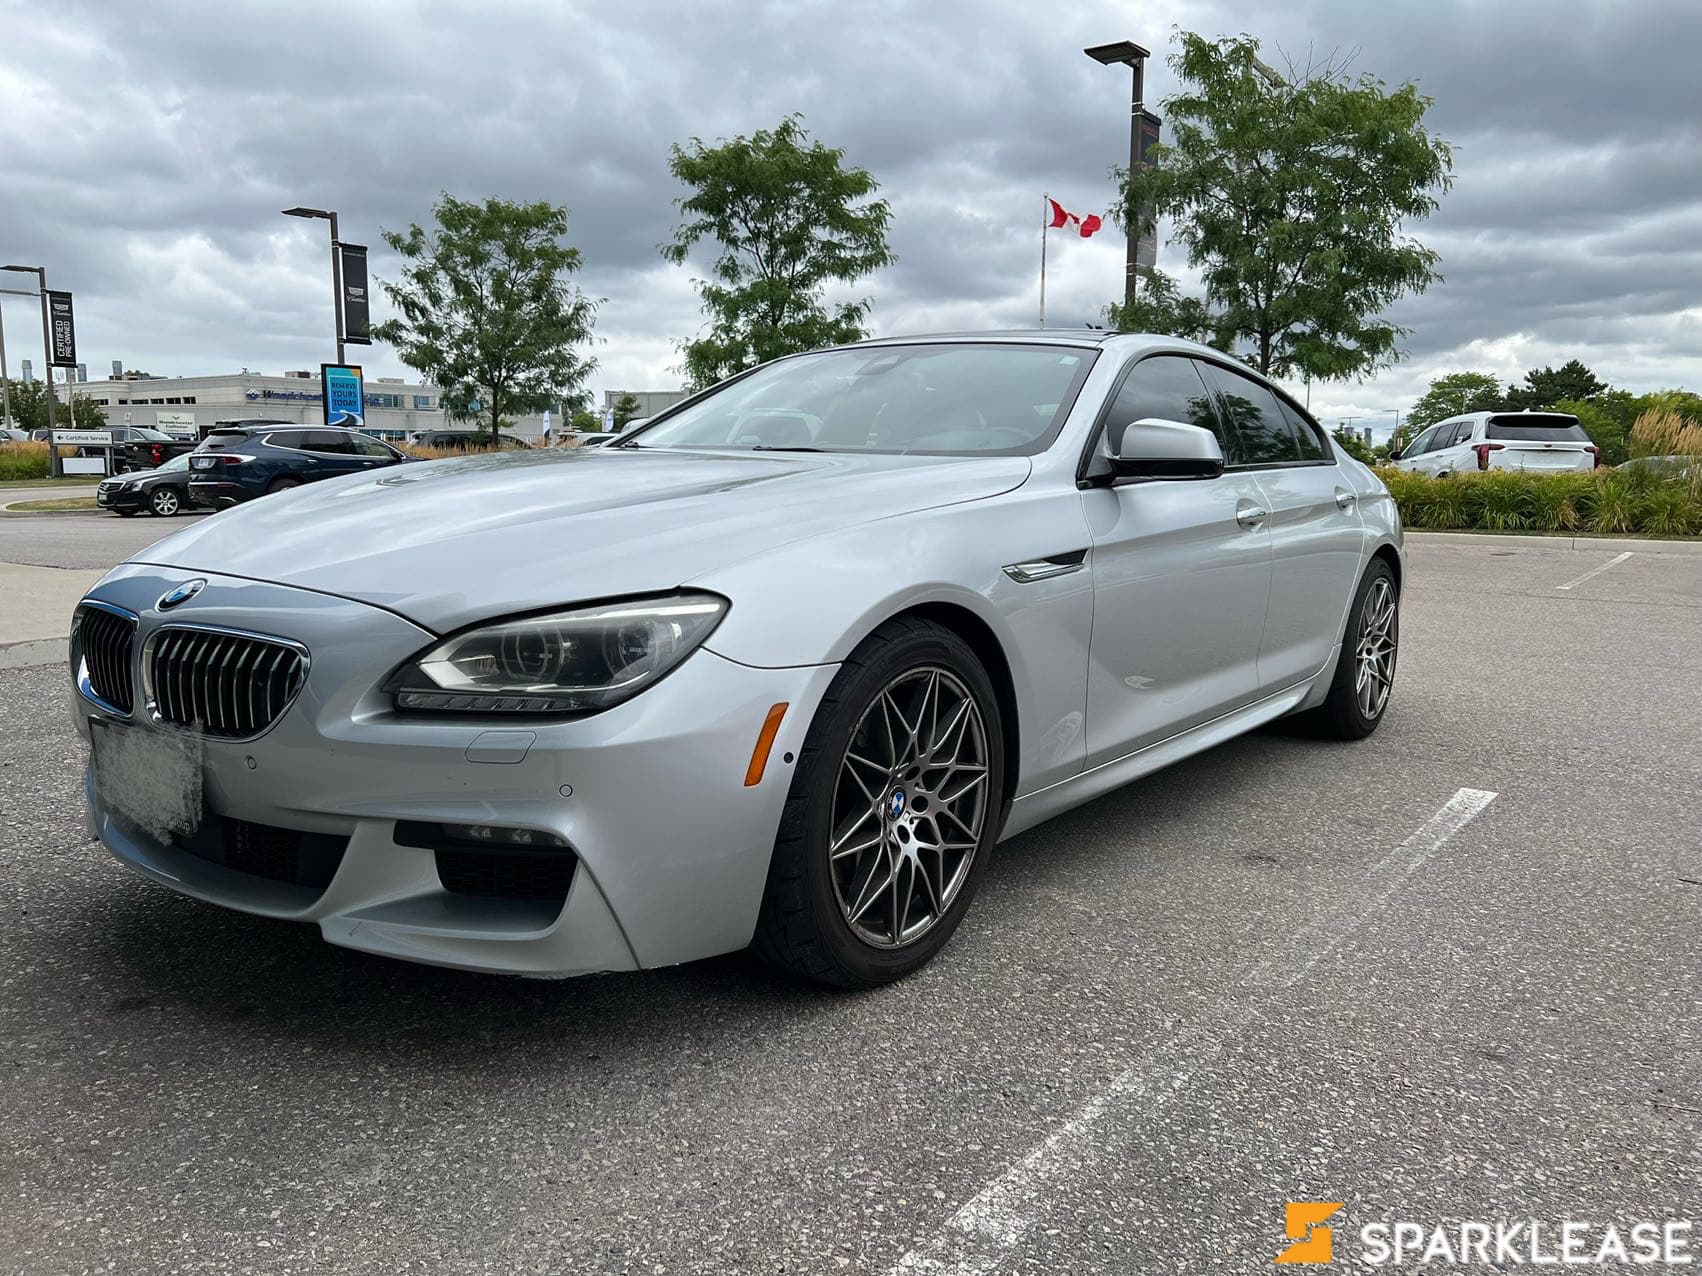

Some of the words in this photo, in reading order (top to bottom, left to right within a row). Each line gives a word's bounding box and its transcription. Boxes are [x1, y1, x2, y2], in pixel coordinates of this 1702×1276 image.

[56, 319, 65, 357] CERTIFIED
[63, 320, 73, 358] PRE-OWNED
[332, 390, 358, 398] YOURS
[333, 399, 357, 407] TODAY
